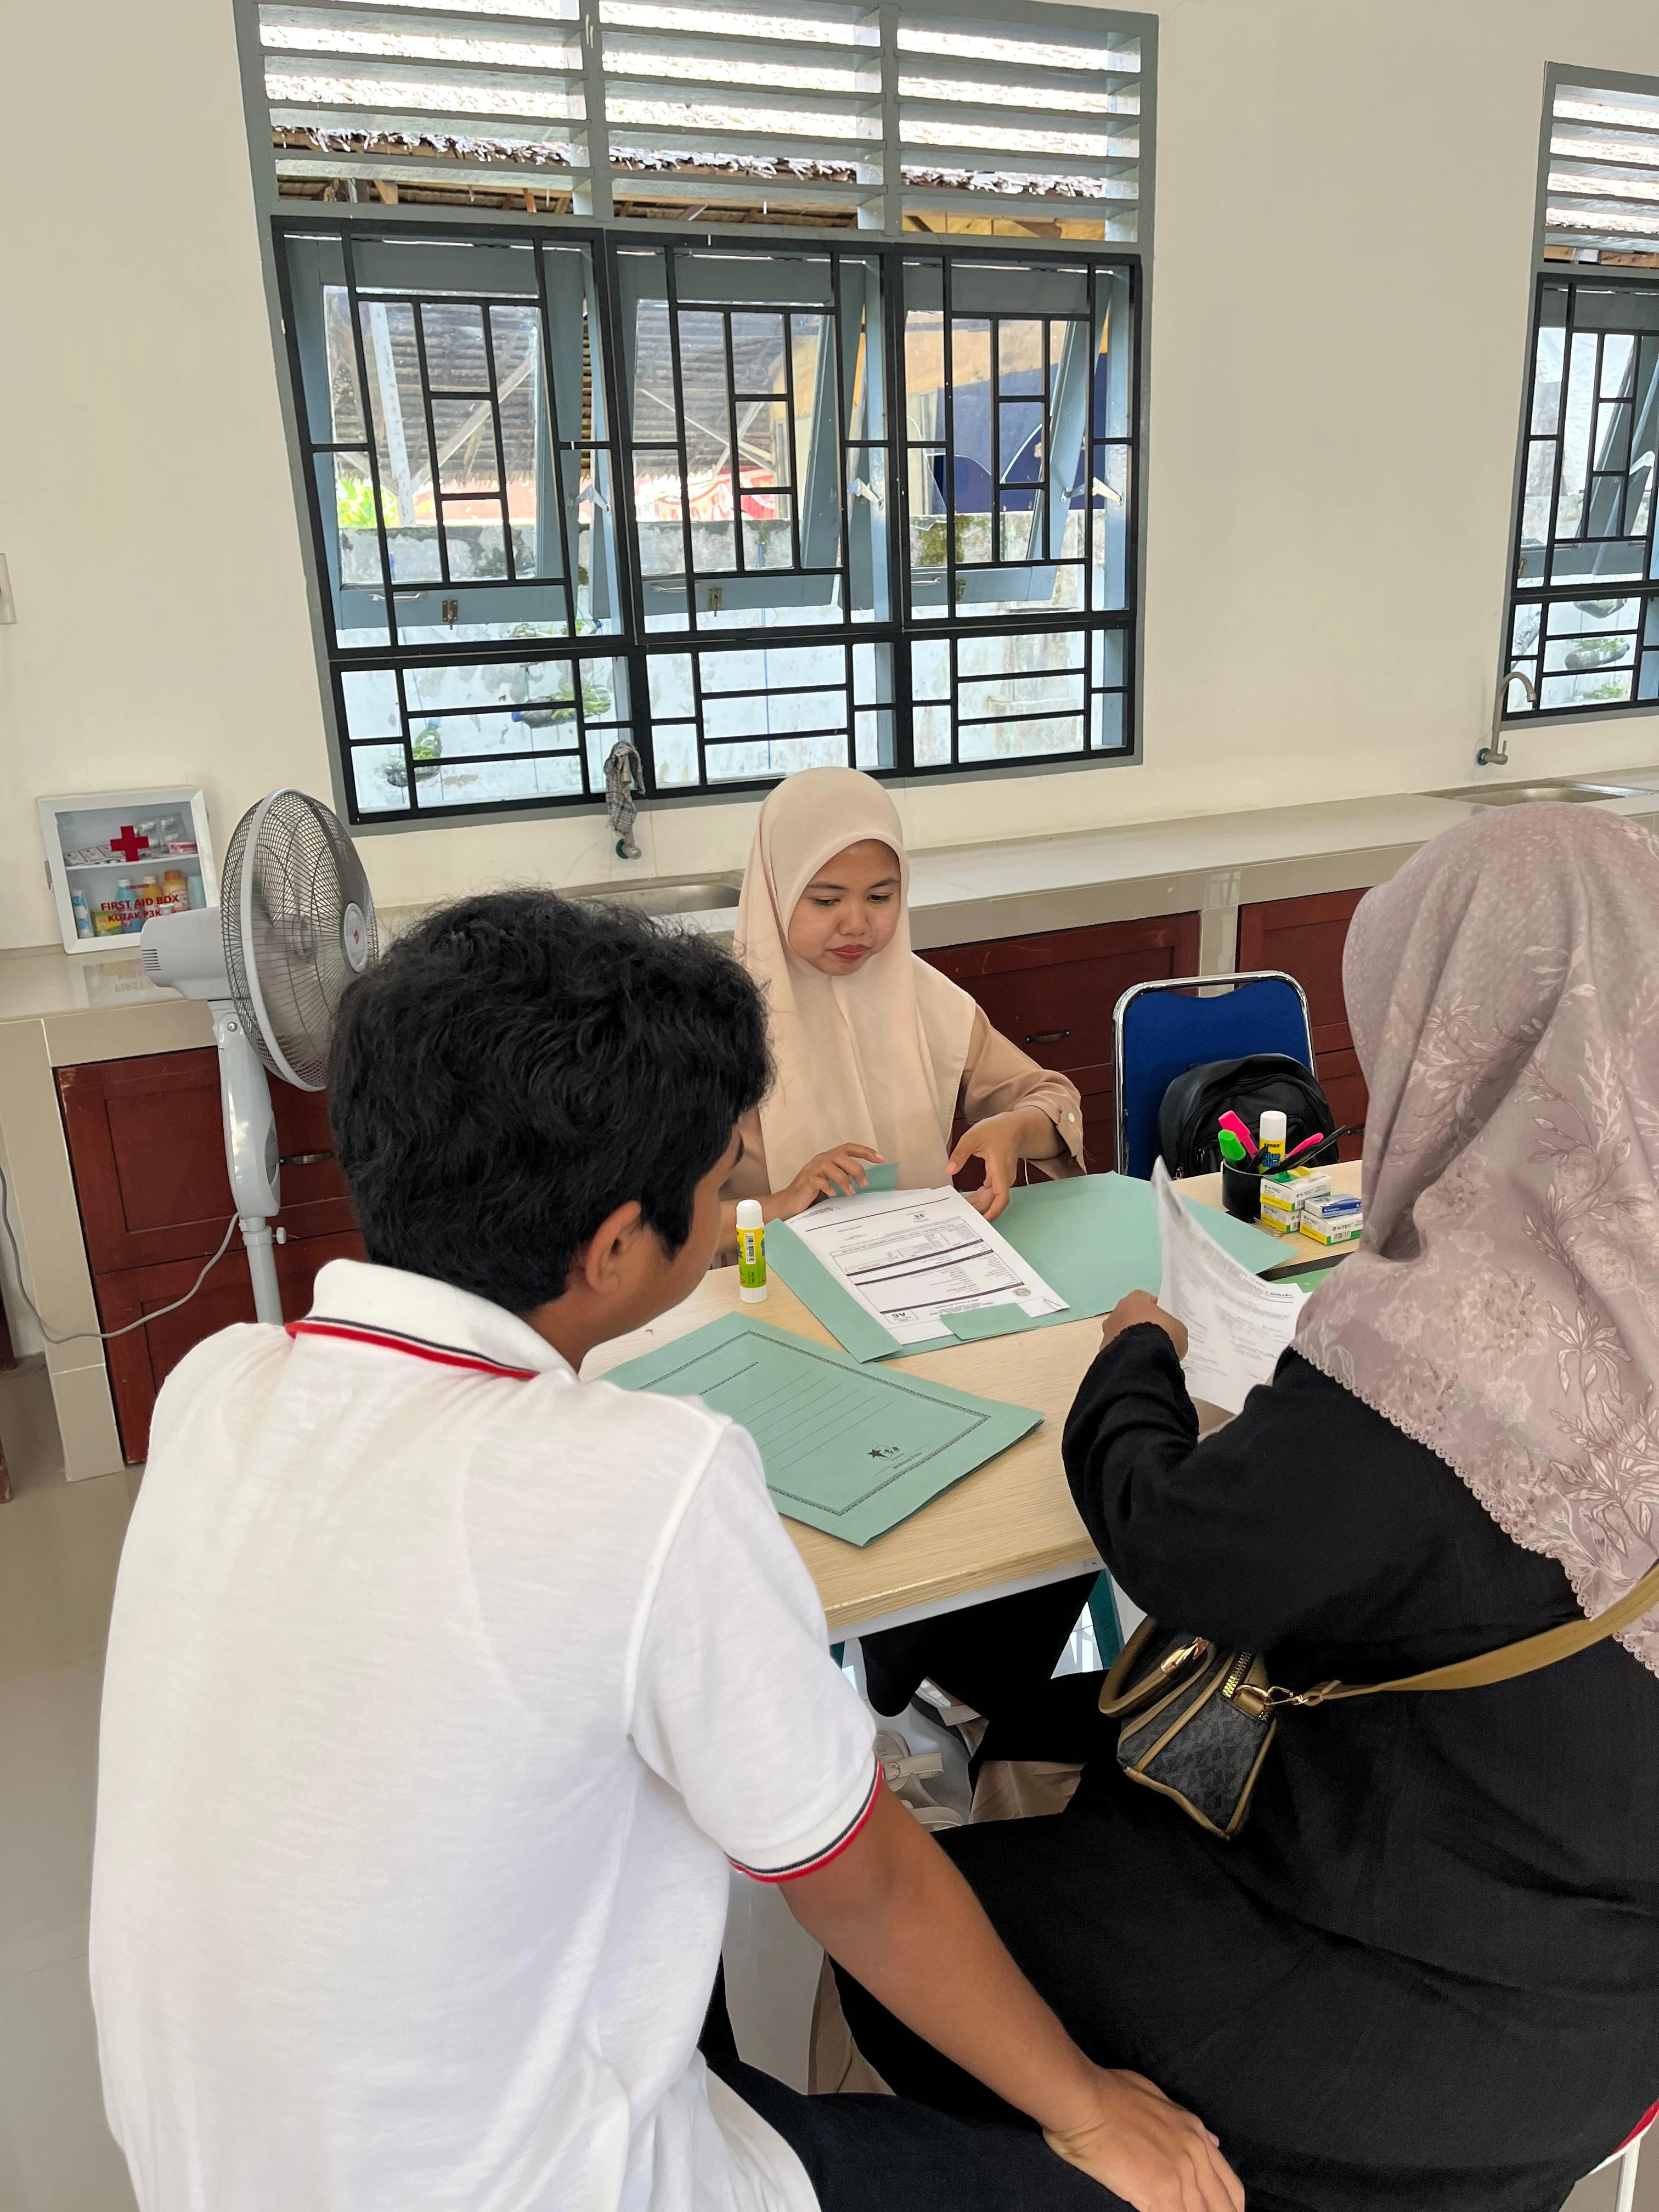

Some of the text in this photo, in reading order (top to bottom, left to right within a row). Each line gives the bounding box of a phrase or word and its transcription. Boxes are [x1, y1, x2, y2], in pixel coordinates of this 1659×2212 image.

[100, 894, 179, 911] FIRST AID BOX
[108, 909, 161, 922] KOTAK P3K
[1265, 1152, 1280, 1160] lue
